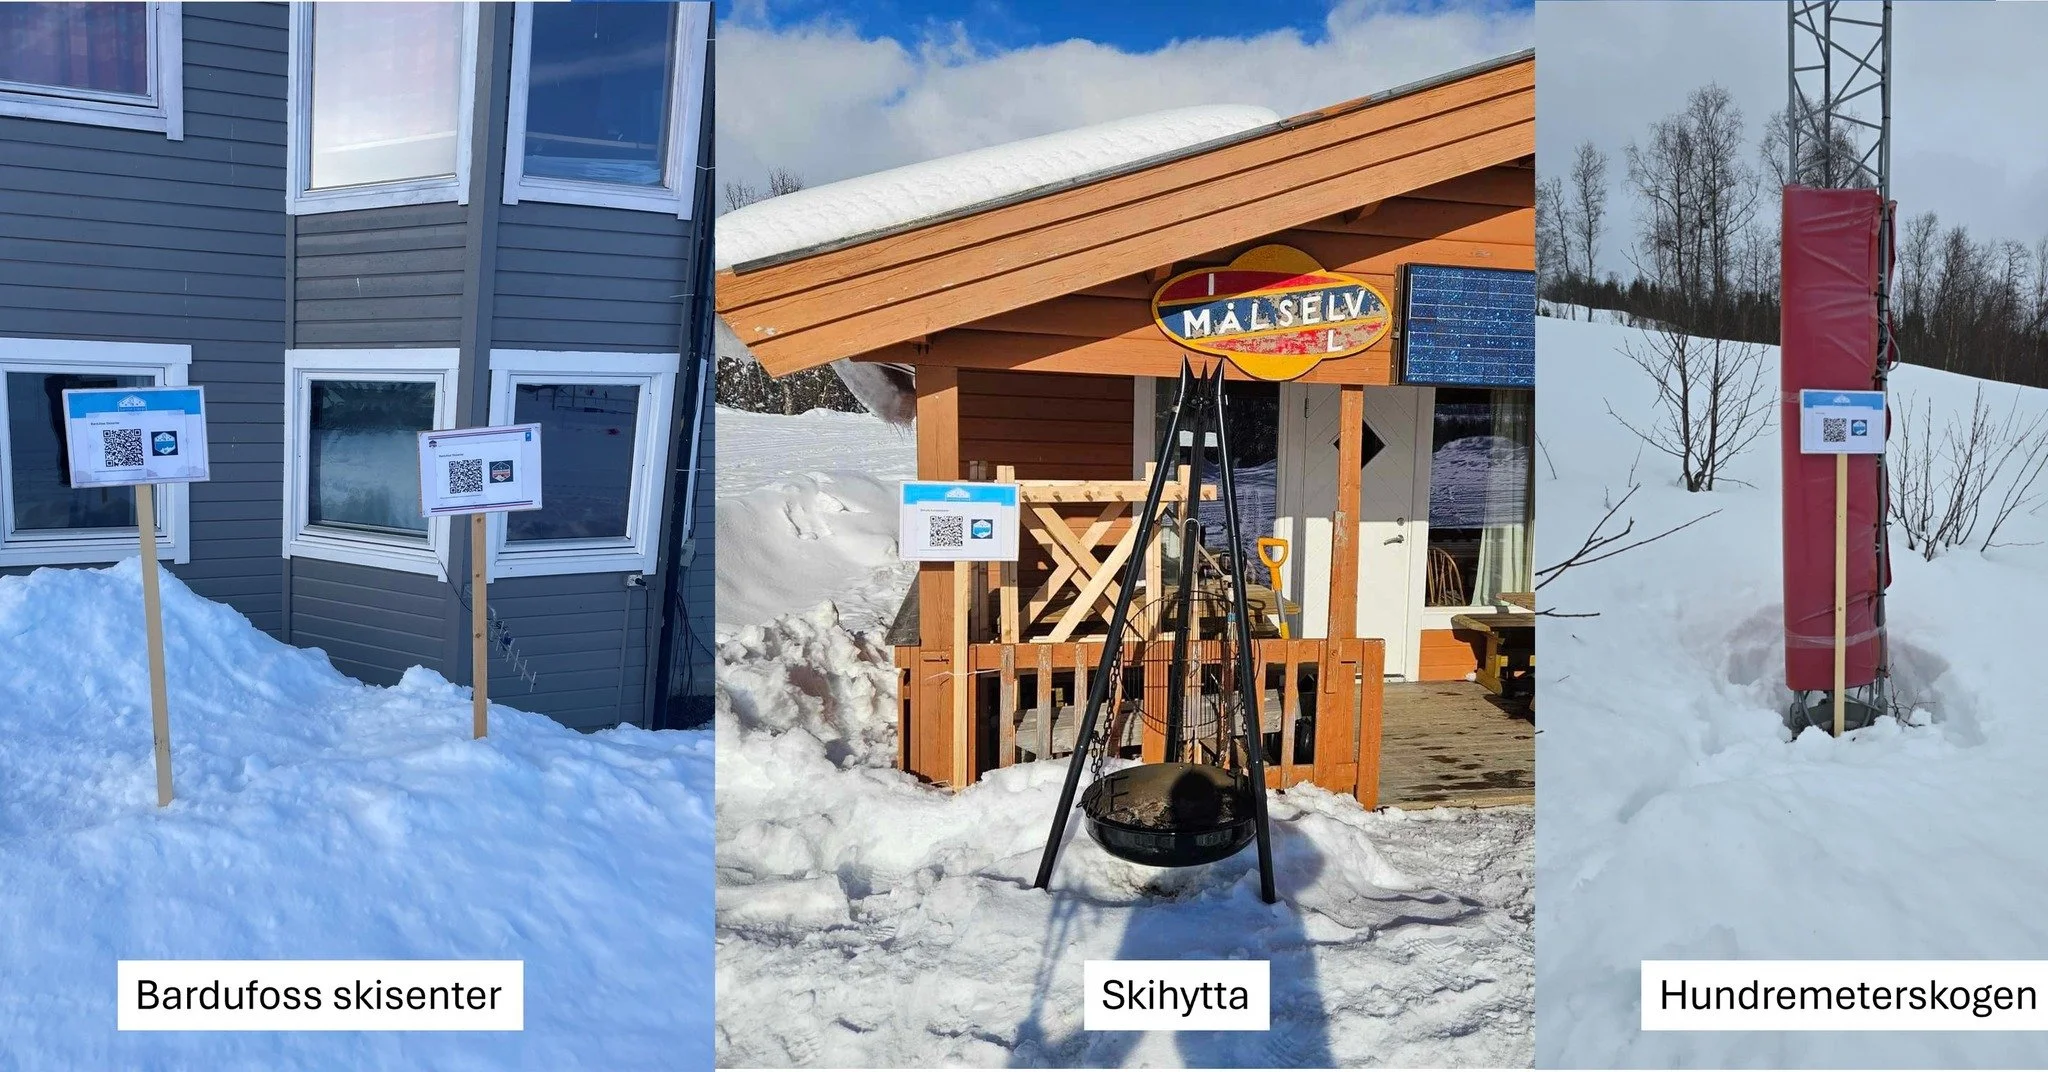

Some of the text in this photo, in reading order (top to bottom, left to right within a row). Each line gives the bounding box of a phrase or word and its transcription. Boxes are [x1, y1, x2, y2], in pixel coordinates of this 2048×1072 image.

[1208, 273, 1215, 295] I
[1183, 290, 1366, 338] MÅLSELV
[1327, 330, 1343, 352] L
